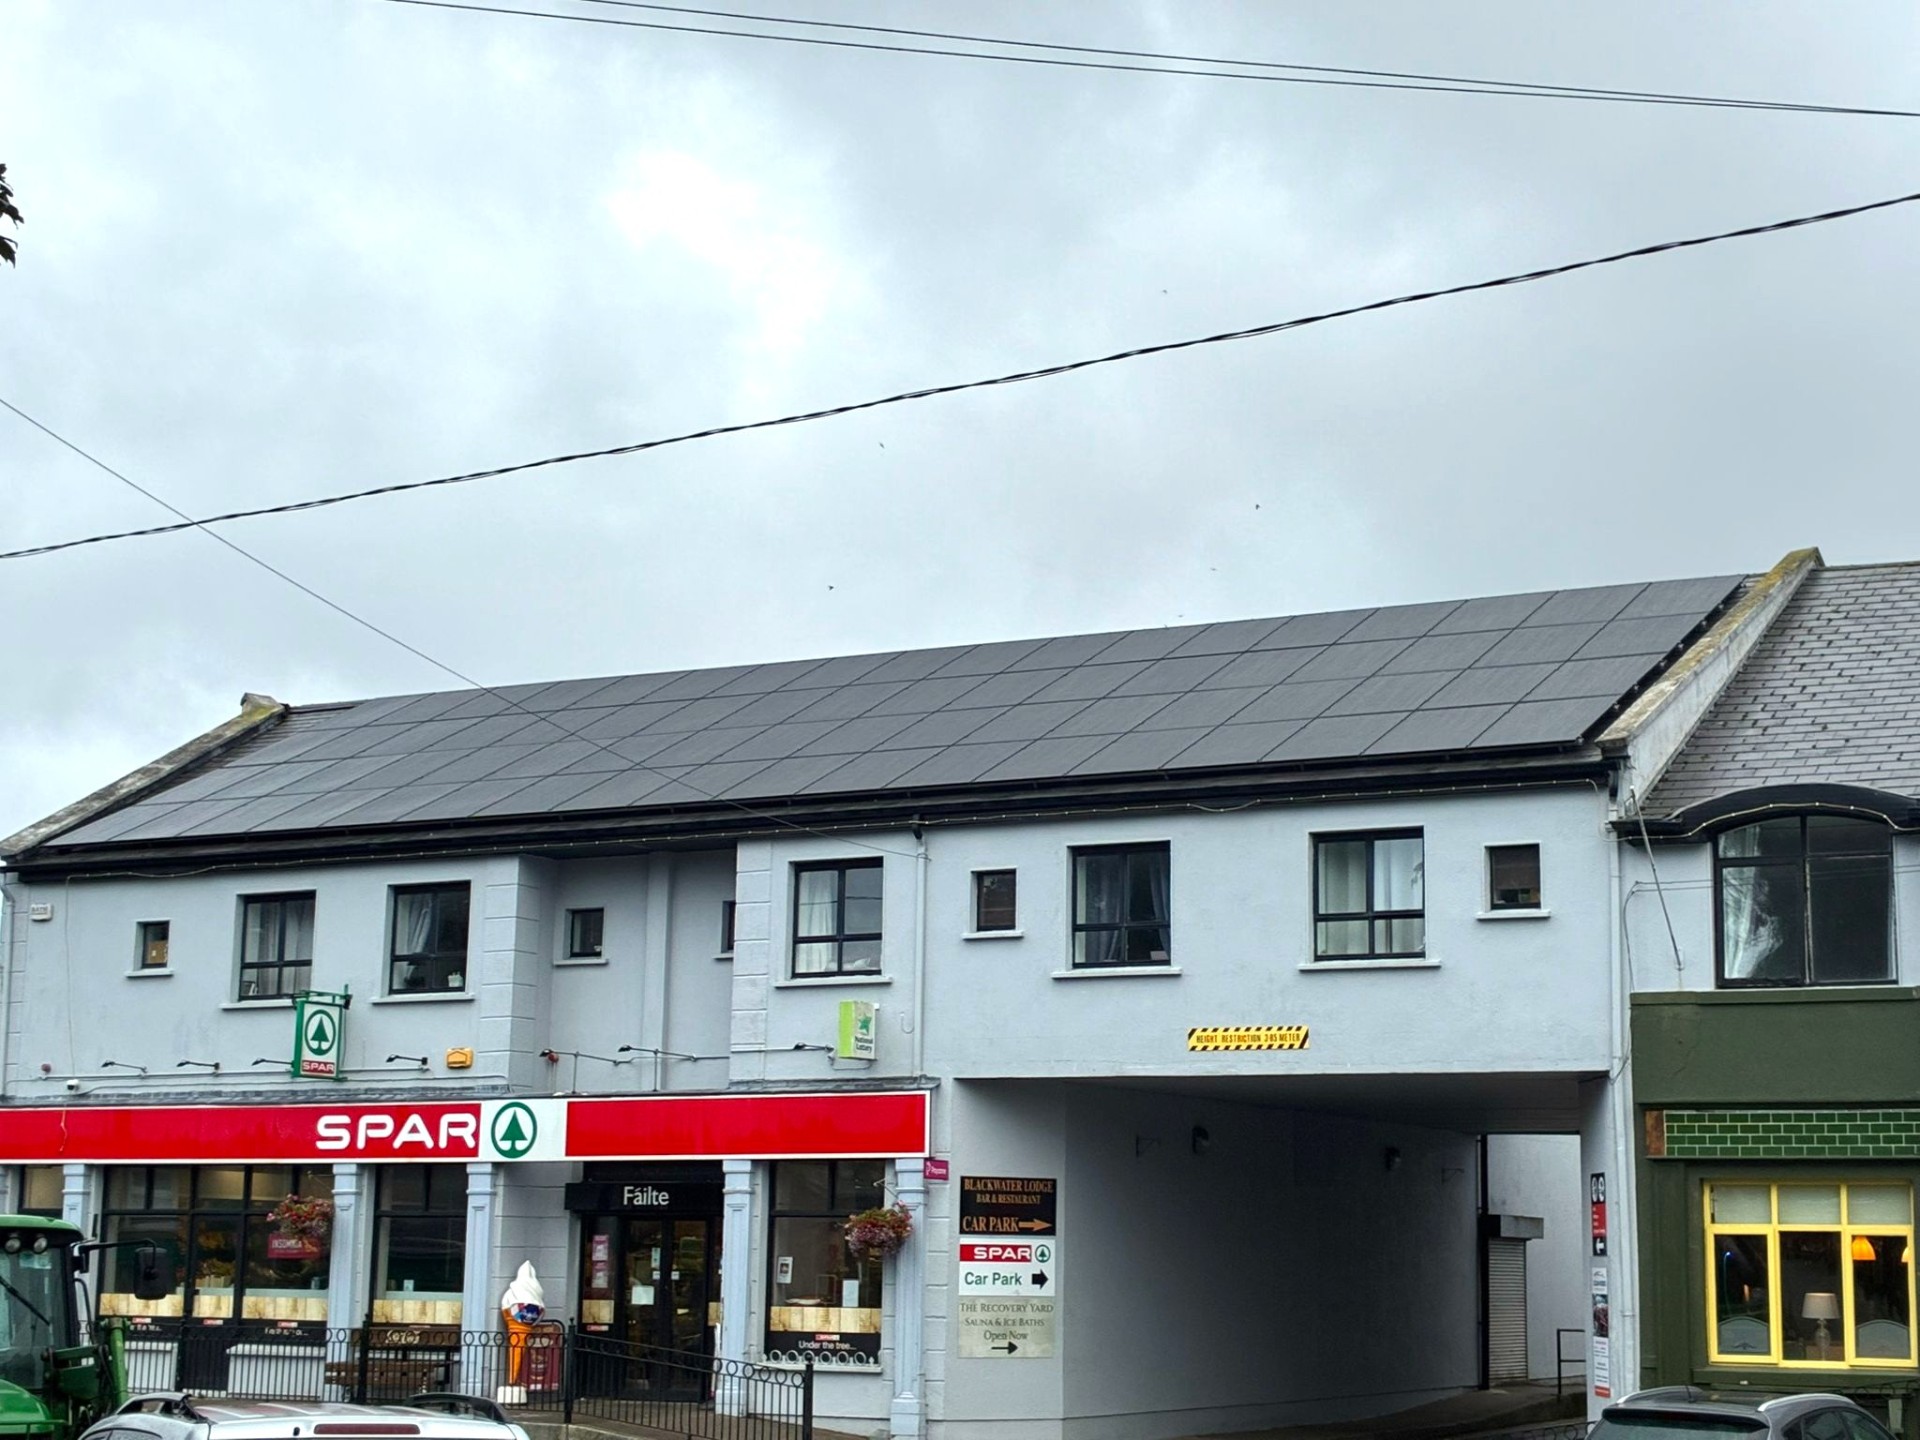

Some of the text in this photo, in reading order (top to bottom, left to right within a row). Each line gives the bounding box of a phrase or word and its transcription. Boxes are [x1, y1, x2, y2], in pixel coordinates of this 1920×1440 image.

[1196, 1034, 1218, 1044] HEIGHT
[1221, 1033, 1261, 1044] RESTRICTION
[1278, 1033, 1300, 1043] METER
[302, 1060, 335, 1072] SPAR
[315, 1112, 478, 1151] SPAR
[964, 1178, 1054, 1193] BLACKWATER LODGE
[623, 1185, 670, 1206] Fáilte
[976, 1193, 992, 1203] BAR
[998, 1194, 1042, 1205] RESTAURANT
[962, 1215, 1020, 1233] CAR PARK
[973, 1246, 1031, 1260] SPAR
[964, 1271, 1023, 1286] Car Park
[960, 1302, 1054, 1313] THE RECOVERY YARD
[964, 1317, 1045, 1327] SAUNA & ICE BATHS
[983, 1329, 1029, 1343] Open Now
[798, 1340, 822, 1349] Under
[822, 1341, 835, 1350] the
